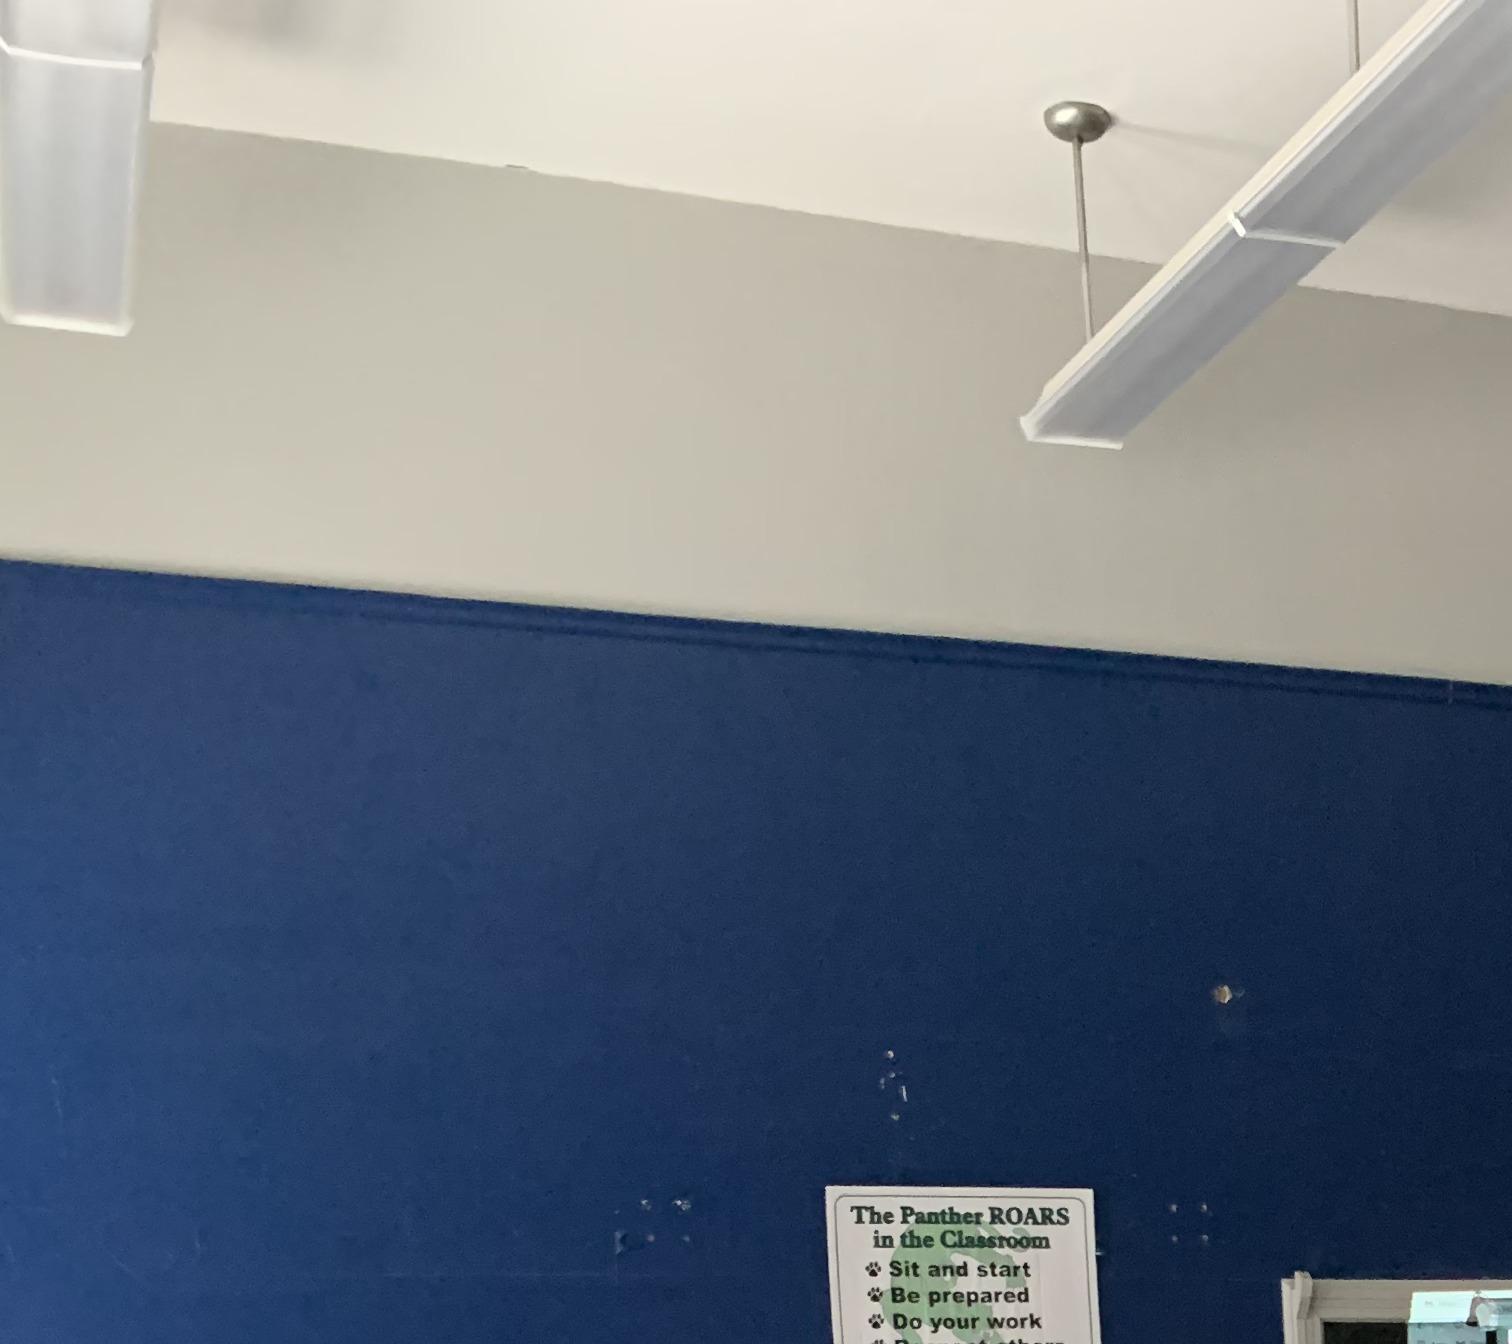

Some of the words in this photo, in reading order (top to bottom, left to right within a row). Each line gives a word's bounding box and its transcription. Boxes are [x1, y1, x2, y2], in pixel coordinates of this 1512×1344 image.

[850, 1206, 894, 1225] The
[900, 1206, 984, 1225] Panther
[989, 1207, 1070, 1225] ROARS
[873, 1230, 894, 1249] in
[900, 1230, 935, 1249] the
[940, 1231, 1051, 1249] Classroom
[889, 1261, 920, 1278] Sit
[928, 1261, 968, 1278] and
[977, 1262, 1031, 1278] start
[890, 1288, 920, 1304] Be
[928, 1287, 1029, 1307] prepared
[893, 1314, 922, 1330] Do
[931, 1316, 980, 1333] your
[987, 1314, 1042, 1330] work
